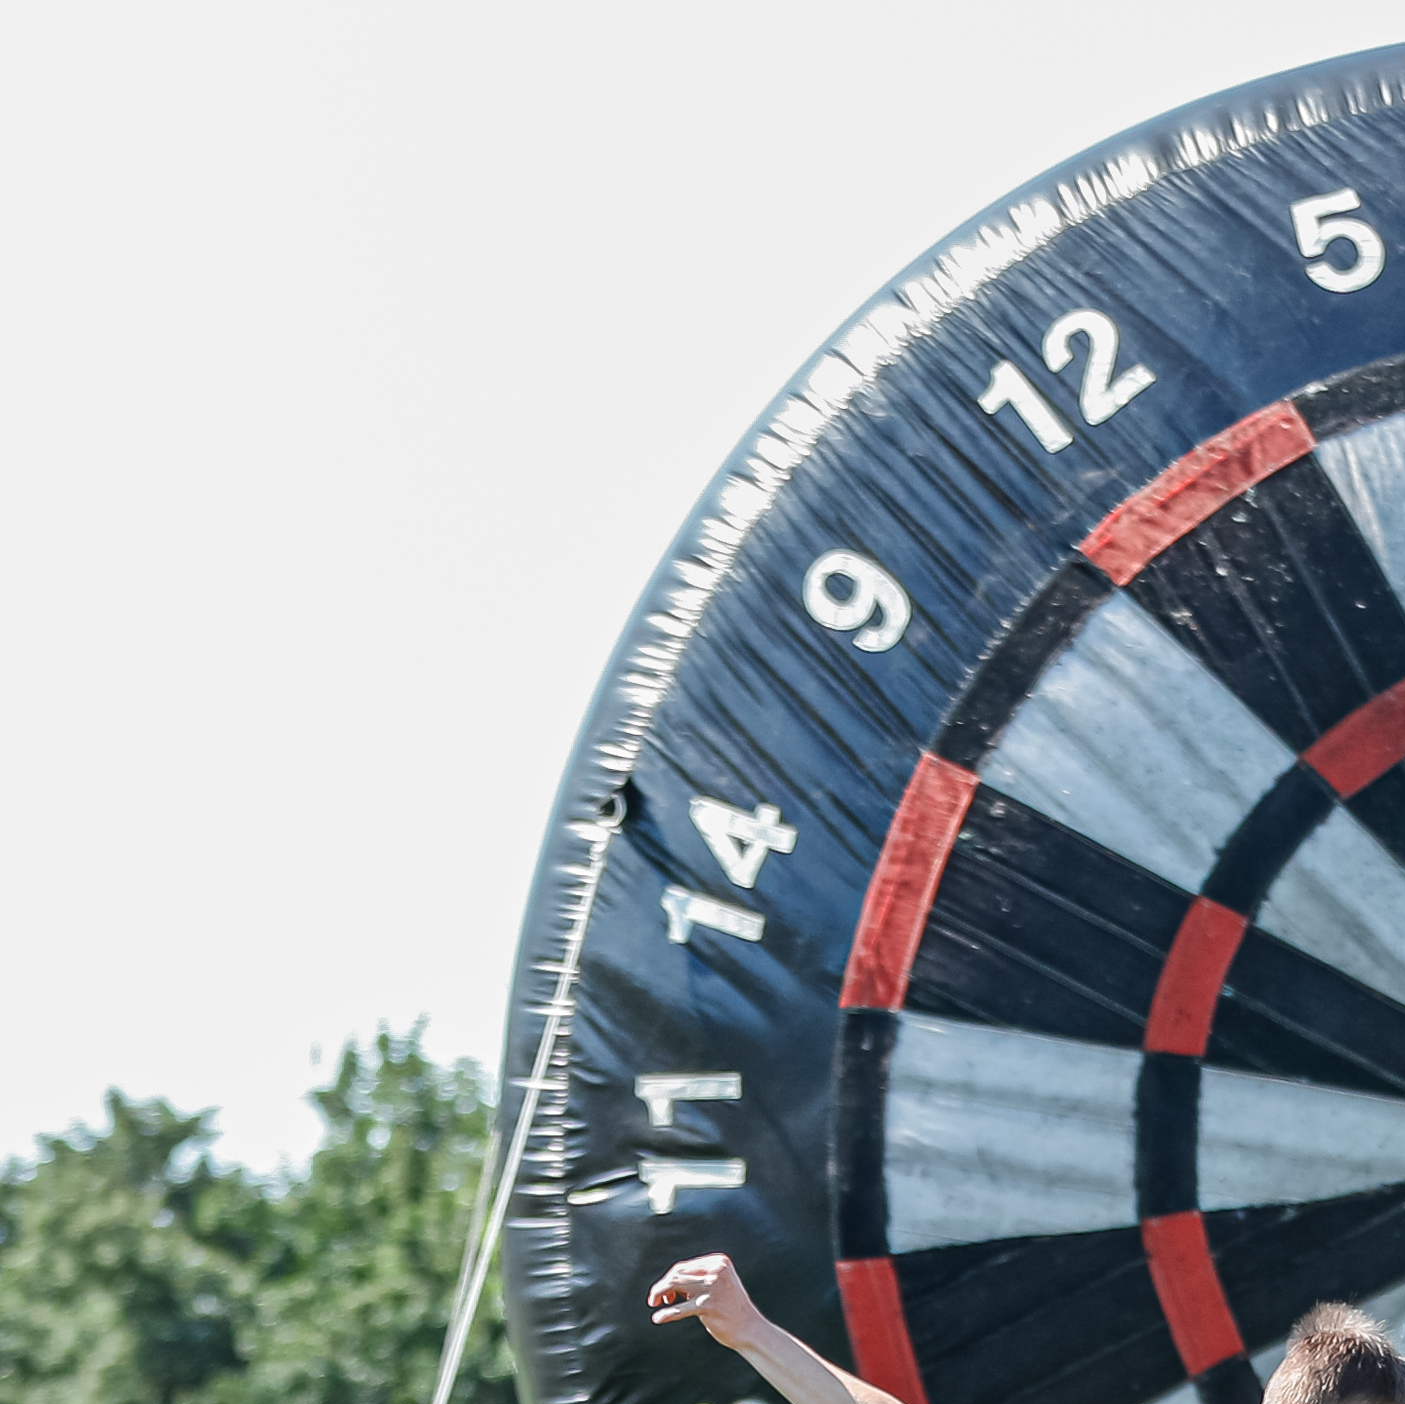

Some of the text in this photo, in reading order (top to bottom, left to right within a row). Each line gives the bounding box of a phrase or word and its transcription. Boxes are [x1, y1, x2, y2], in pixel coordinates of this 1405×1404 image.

[1290, 187, 1386, 293] 5
[977, 307, 1156, 454] 12
[801, 548, 911, 652] 9
[660, 796, 798, 944] 14
[634, 1072, 747, 1215] 11
